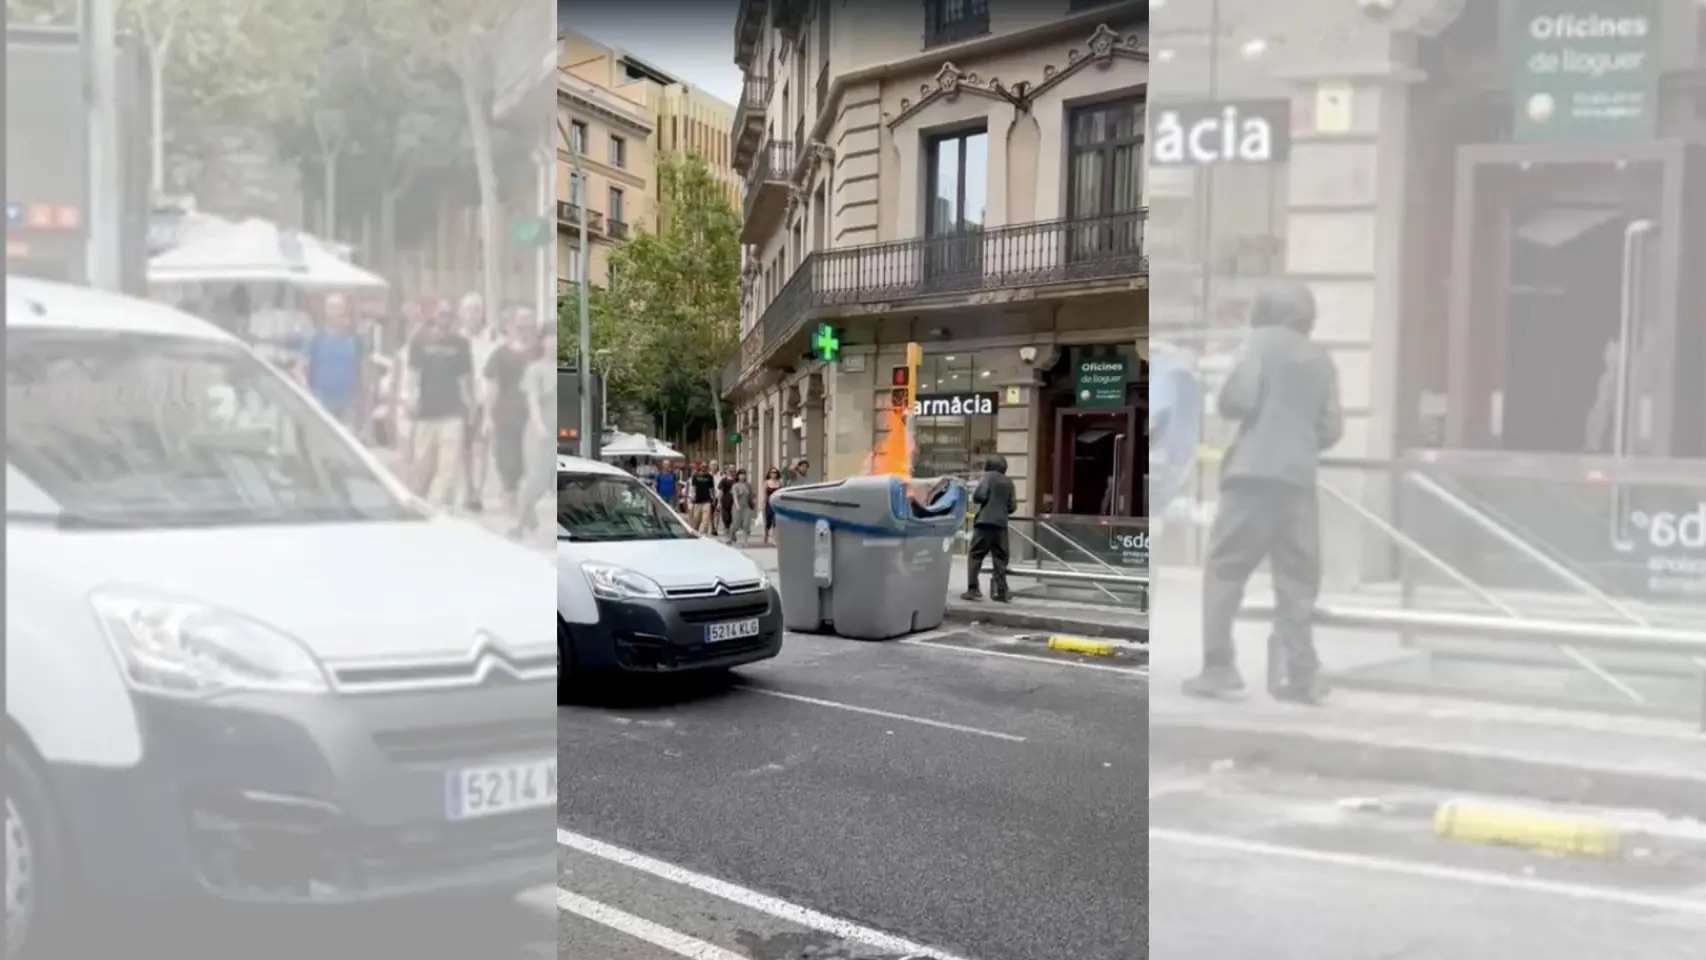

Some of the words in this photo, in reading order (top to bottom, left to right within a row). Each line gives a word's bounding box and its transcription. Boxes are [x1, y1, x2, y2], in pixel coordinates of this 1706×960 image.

[1529, 13, 1648, 40] Oficines
[1527, 52, 1559, 73] de
[1563, 49, 1645, 77] lloguer
[1082, 363, 1123, 371] Oficines
[914, 394, 992, 415] armàcia
[713, 624, 736, 639] 5214
[740, 621, 757, 634] KLG
[468, 767, 537, 809] 5214
